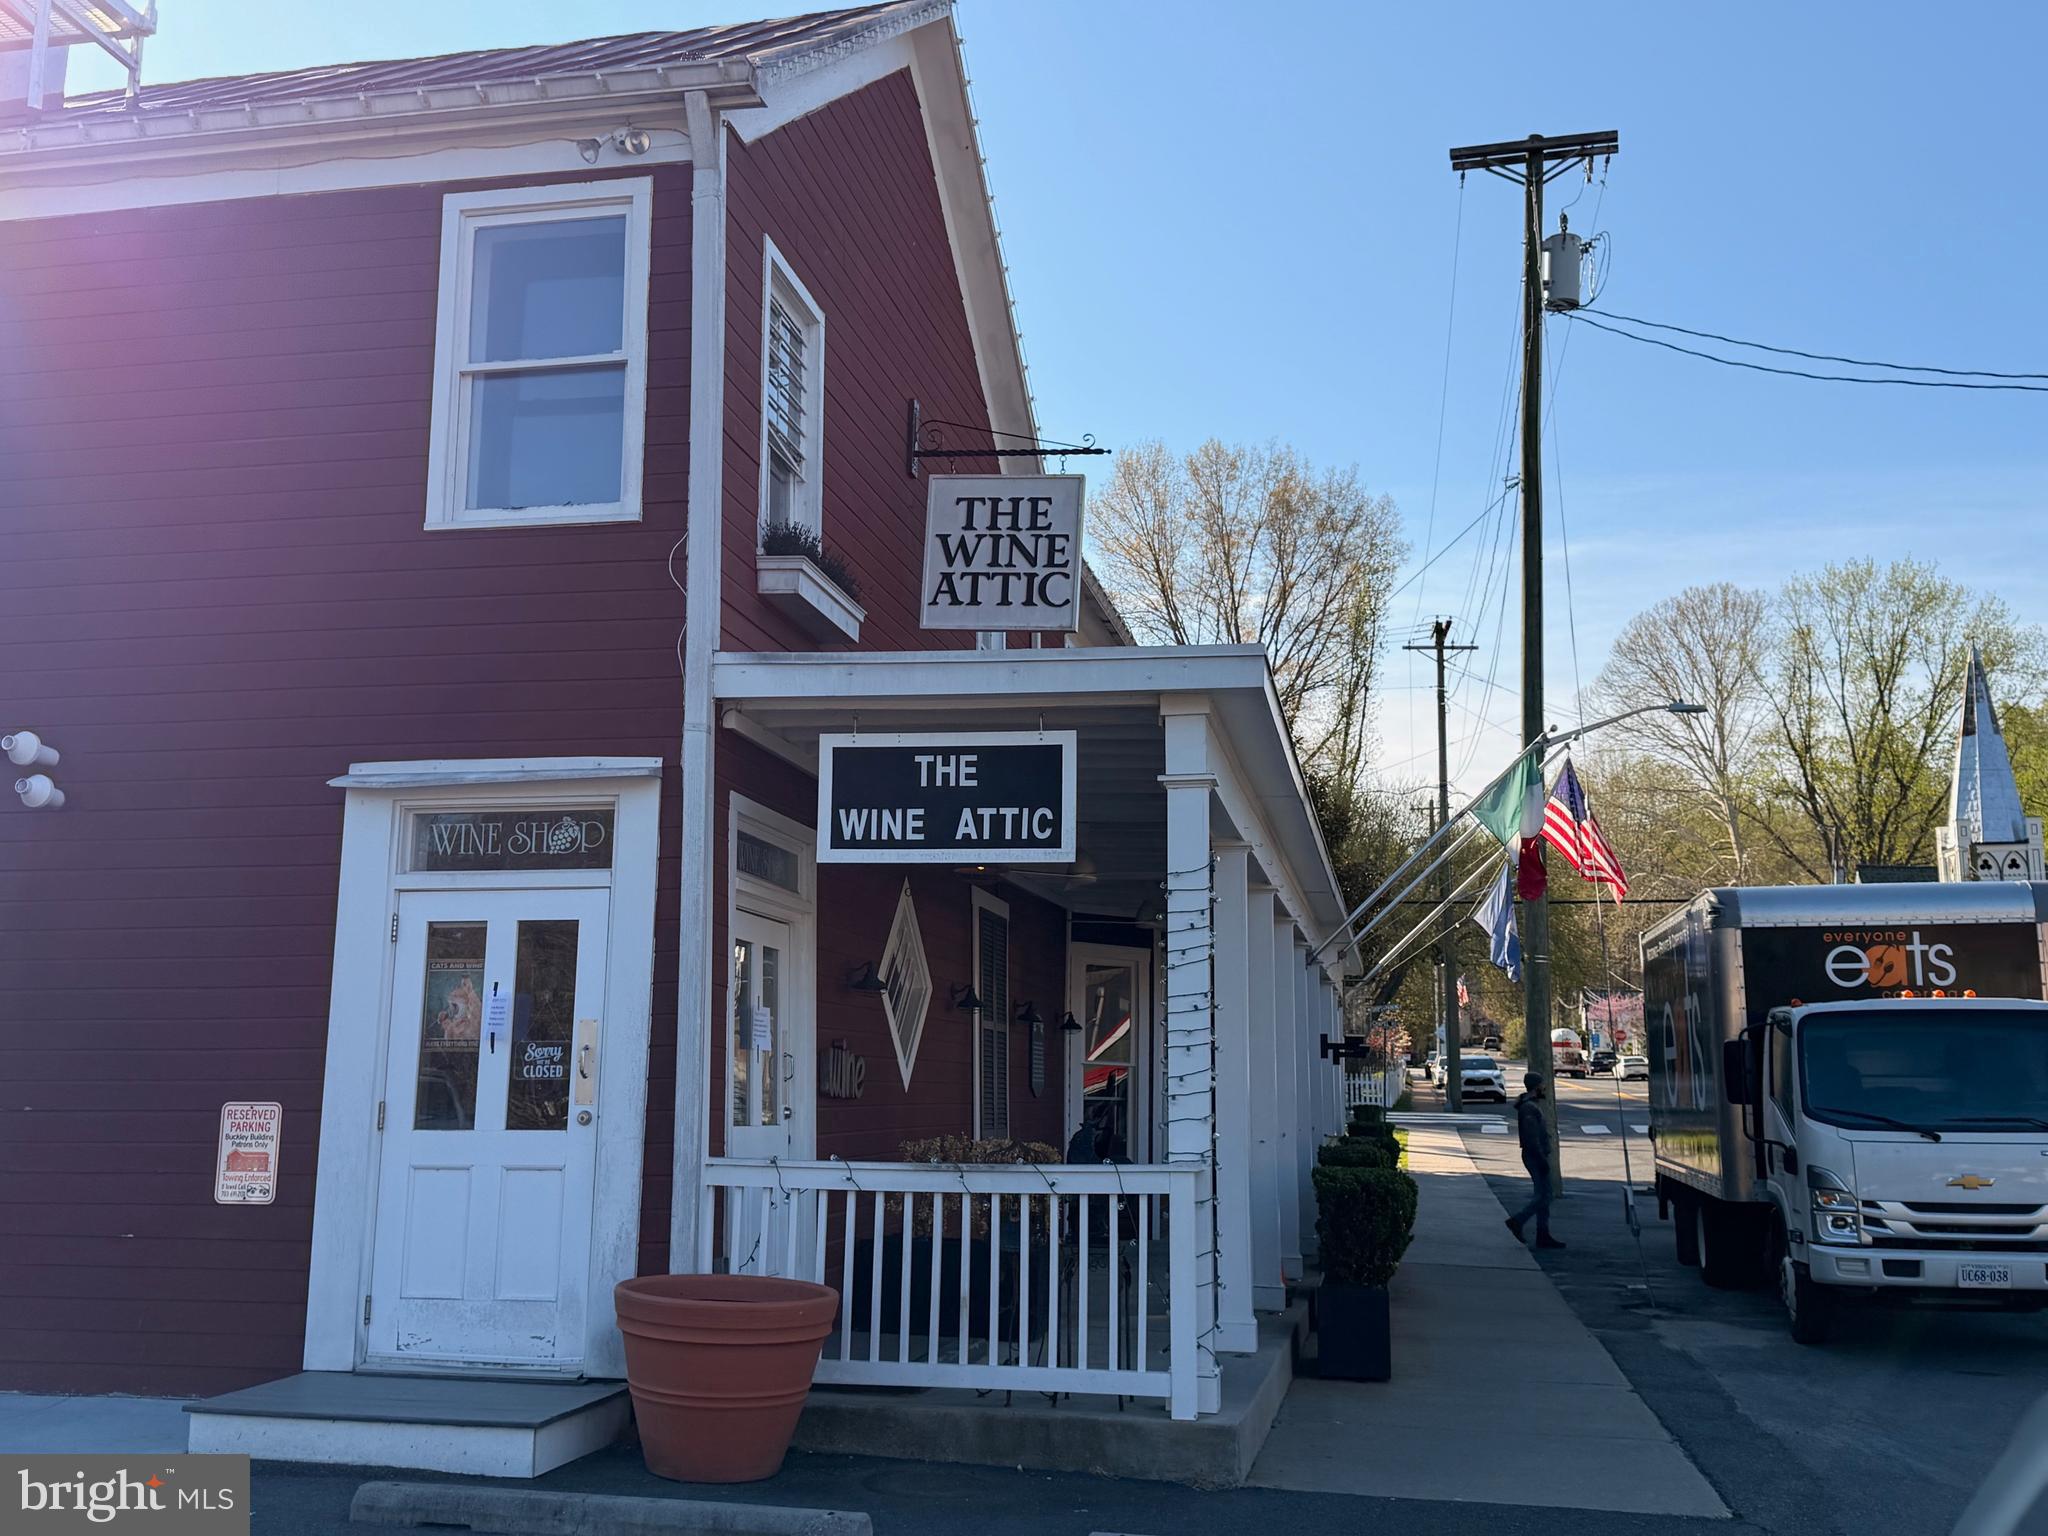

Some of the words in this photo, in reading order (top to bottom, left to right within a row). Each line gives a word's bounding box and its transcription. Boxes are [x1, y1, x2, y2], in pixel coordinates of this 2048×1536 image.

[956, 497, 1053, 531] THE
[935, 533, 1071, 568] WINE
[927, 571, 1071, 608] ATTIC
[914, 754, 978, 788] THE
[838, 808, 925, 841] WINE
[955, 807, 1054, 840] ATTIC
[431, 823, 503, 856] WINE
[507, 819, 605, 855] SHOP
[1823, 931, 1906, 944] everyone
[1825, 931, 1957, 988] eats
[524, 1043, 564, 1062] Sorry
[523, 1065, 563, 1078] CLOSED
[227, 1109, 276, 1120] RESERVED
[230, 1121, 271, 1132] PARKING
[225, 1133, 248, 1141] Buckley
[250, 1133, 274, 1142] Building
[222, 1173, 244, 1183] Towing
[244, 1173, 272, 1182] Enforced
